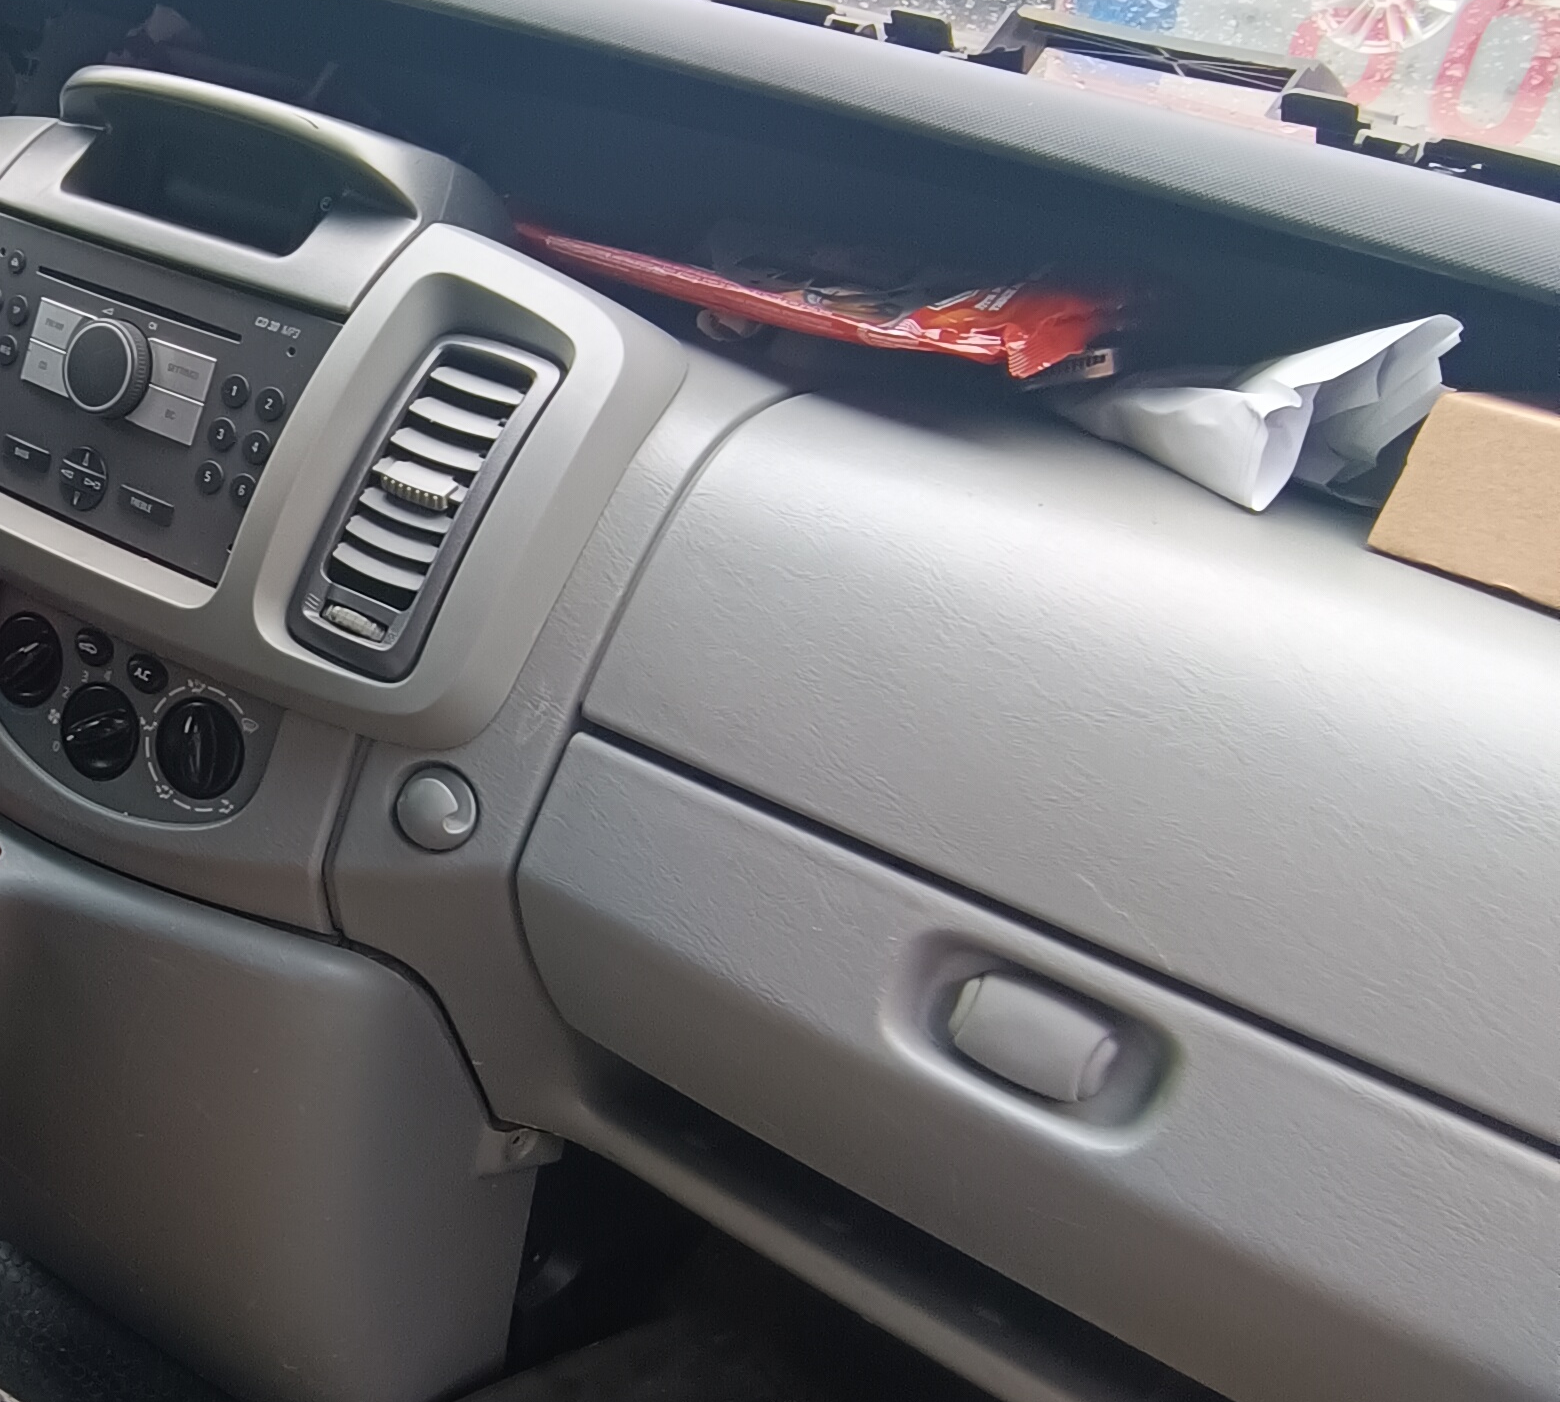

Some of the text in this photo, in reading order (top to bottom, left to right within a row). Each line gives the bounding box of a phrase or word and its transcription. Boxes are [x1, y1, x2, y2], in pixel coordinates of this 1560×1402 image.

[254, 316, 270, 328] CD
[280, 325, 301, 339] MP3
[264, 397, 274, 411] 2
[216, 428, 225, 440] 3
[251, 441, 260, 453] 4
[203, 470, 213, 483] 5
[237, 484, 246, 496] 6
[130, 496, 153, 514] TREBLE
[81, 669, 89, 684] 3
[61, 685, 71, 699] 2
